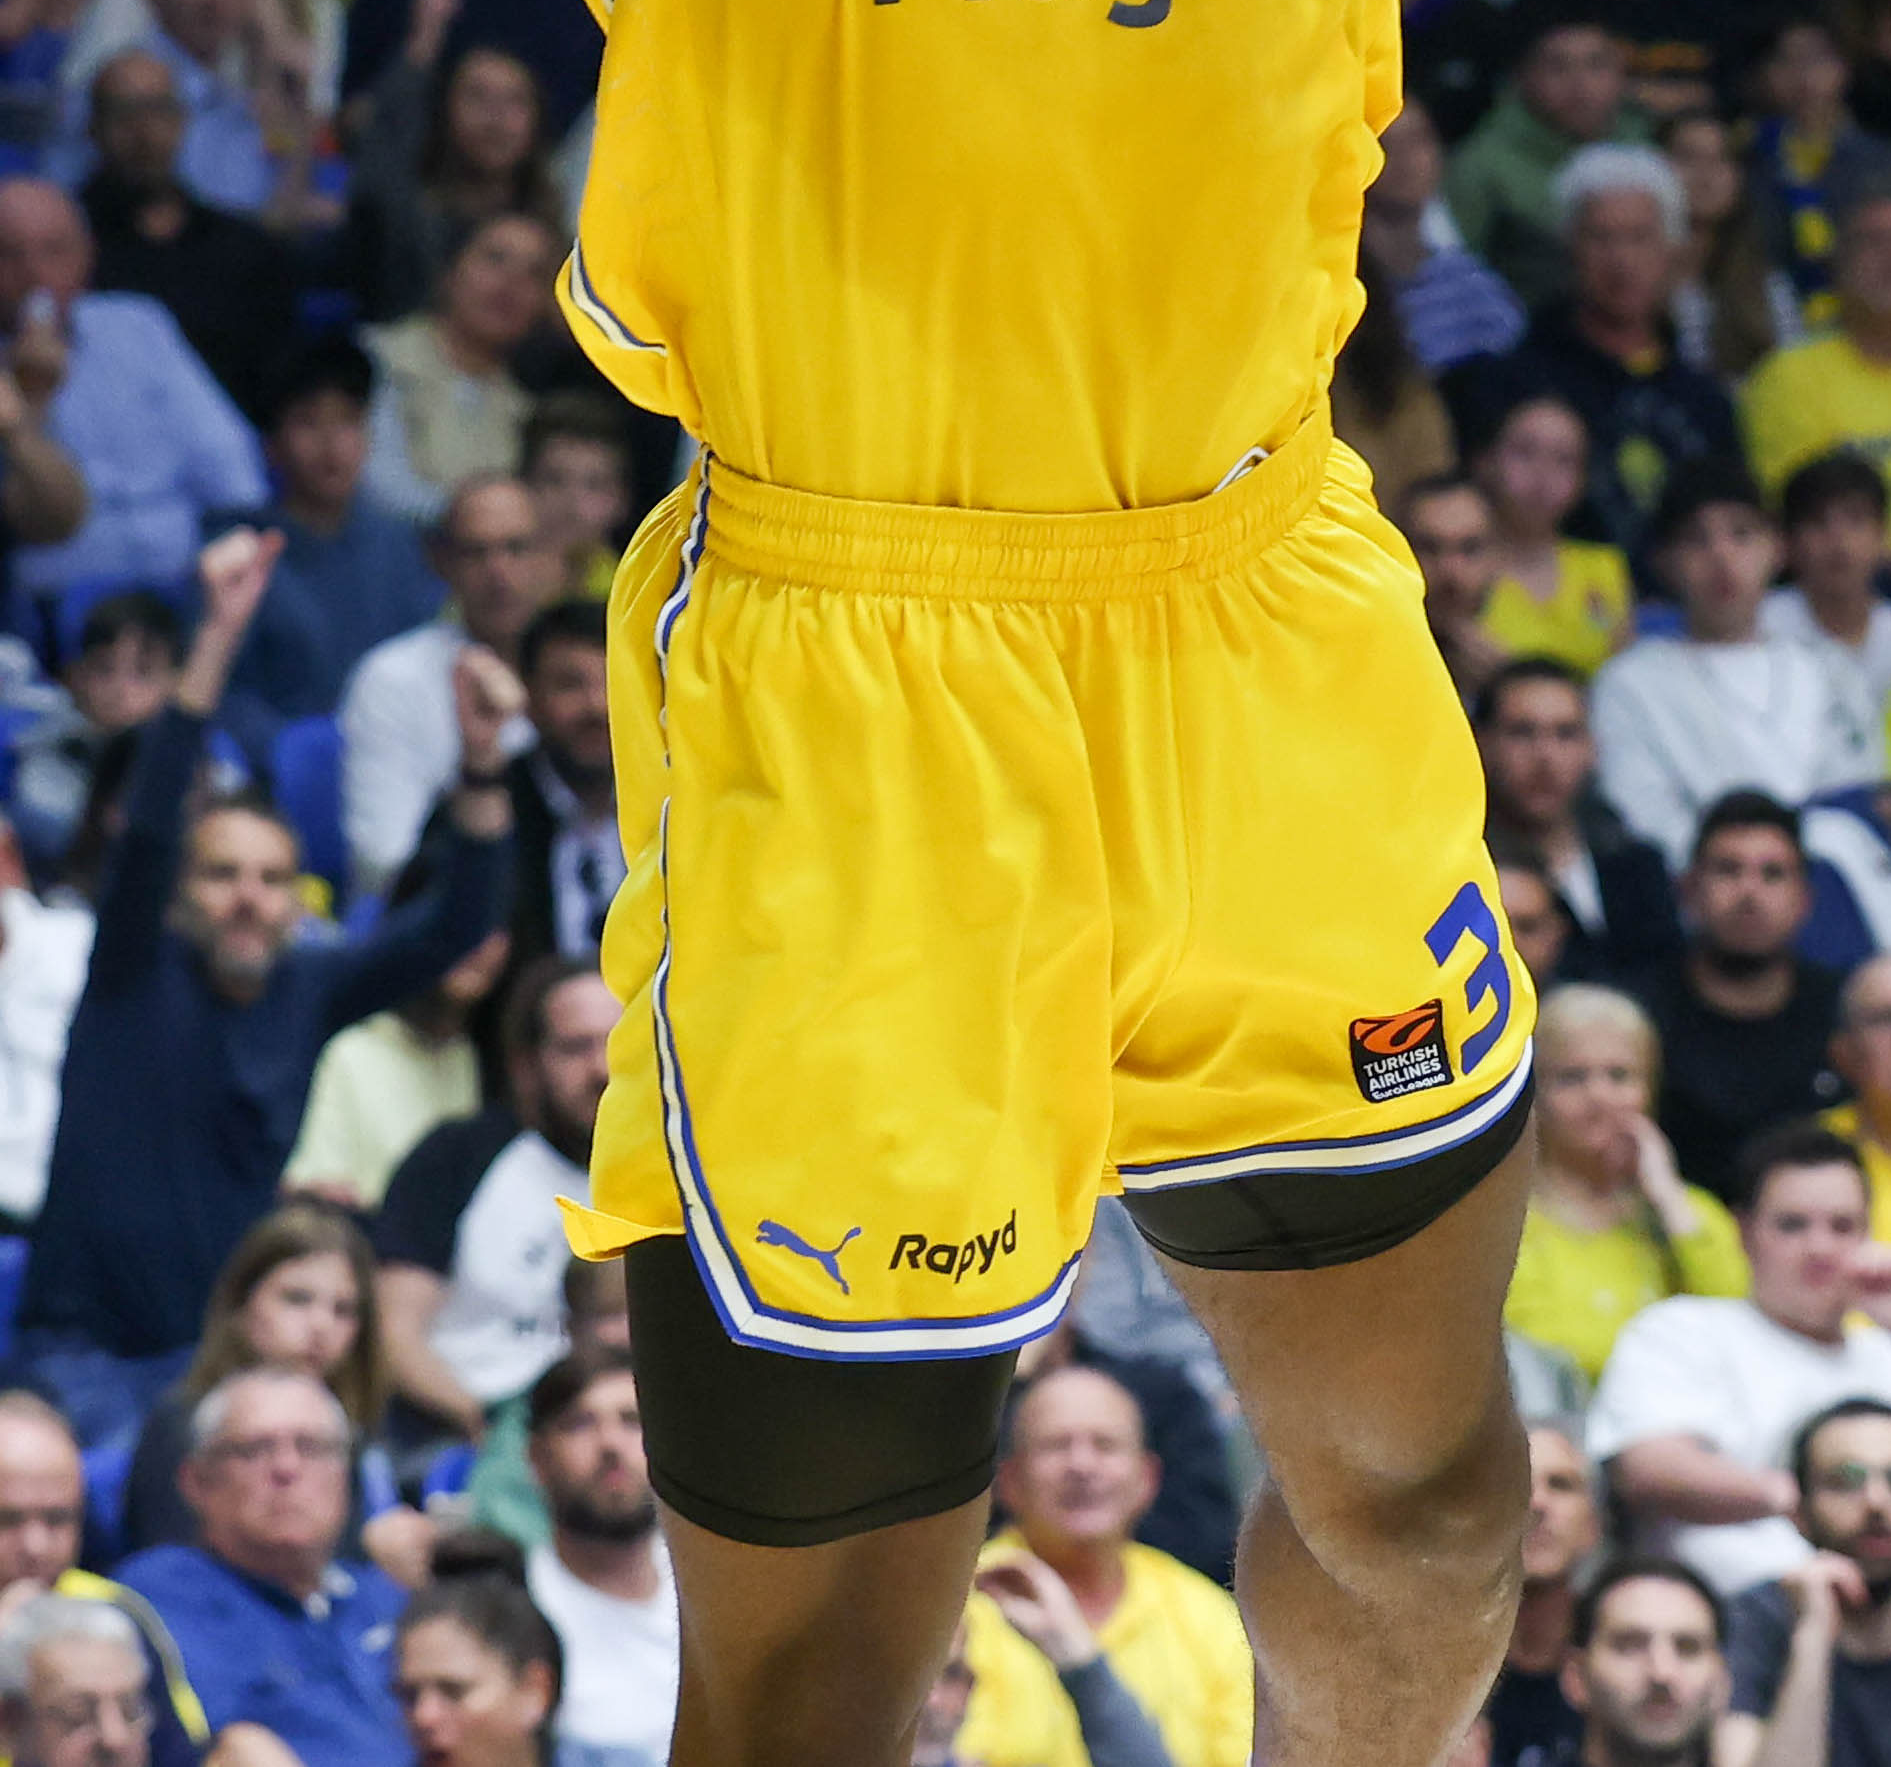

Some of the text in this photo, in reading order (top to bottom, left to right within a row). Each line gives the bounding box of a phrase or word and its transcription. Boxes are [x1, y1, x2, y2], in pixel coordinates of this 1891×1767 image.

[1424, 881, 1510, 1075] 3
[1363, 1043, 1439, 1077] TURKISH
[1369, 1057, 1442, 1092] AIRLINES
[1371, 1073, 1446, 1100] EuroLeague
[889, 1208, 1017, 1284] Rapyd
